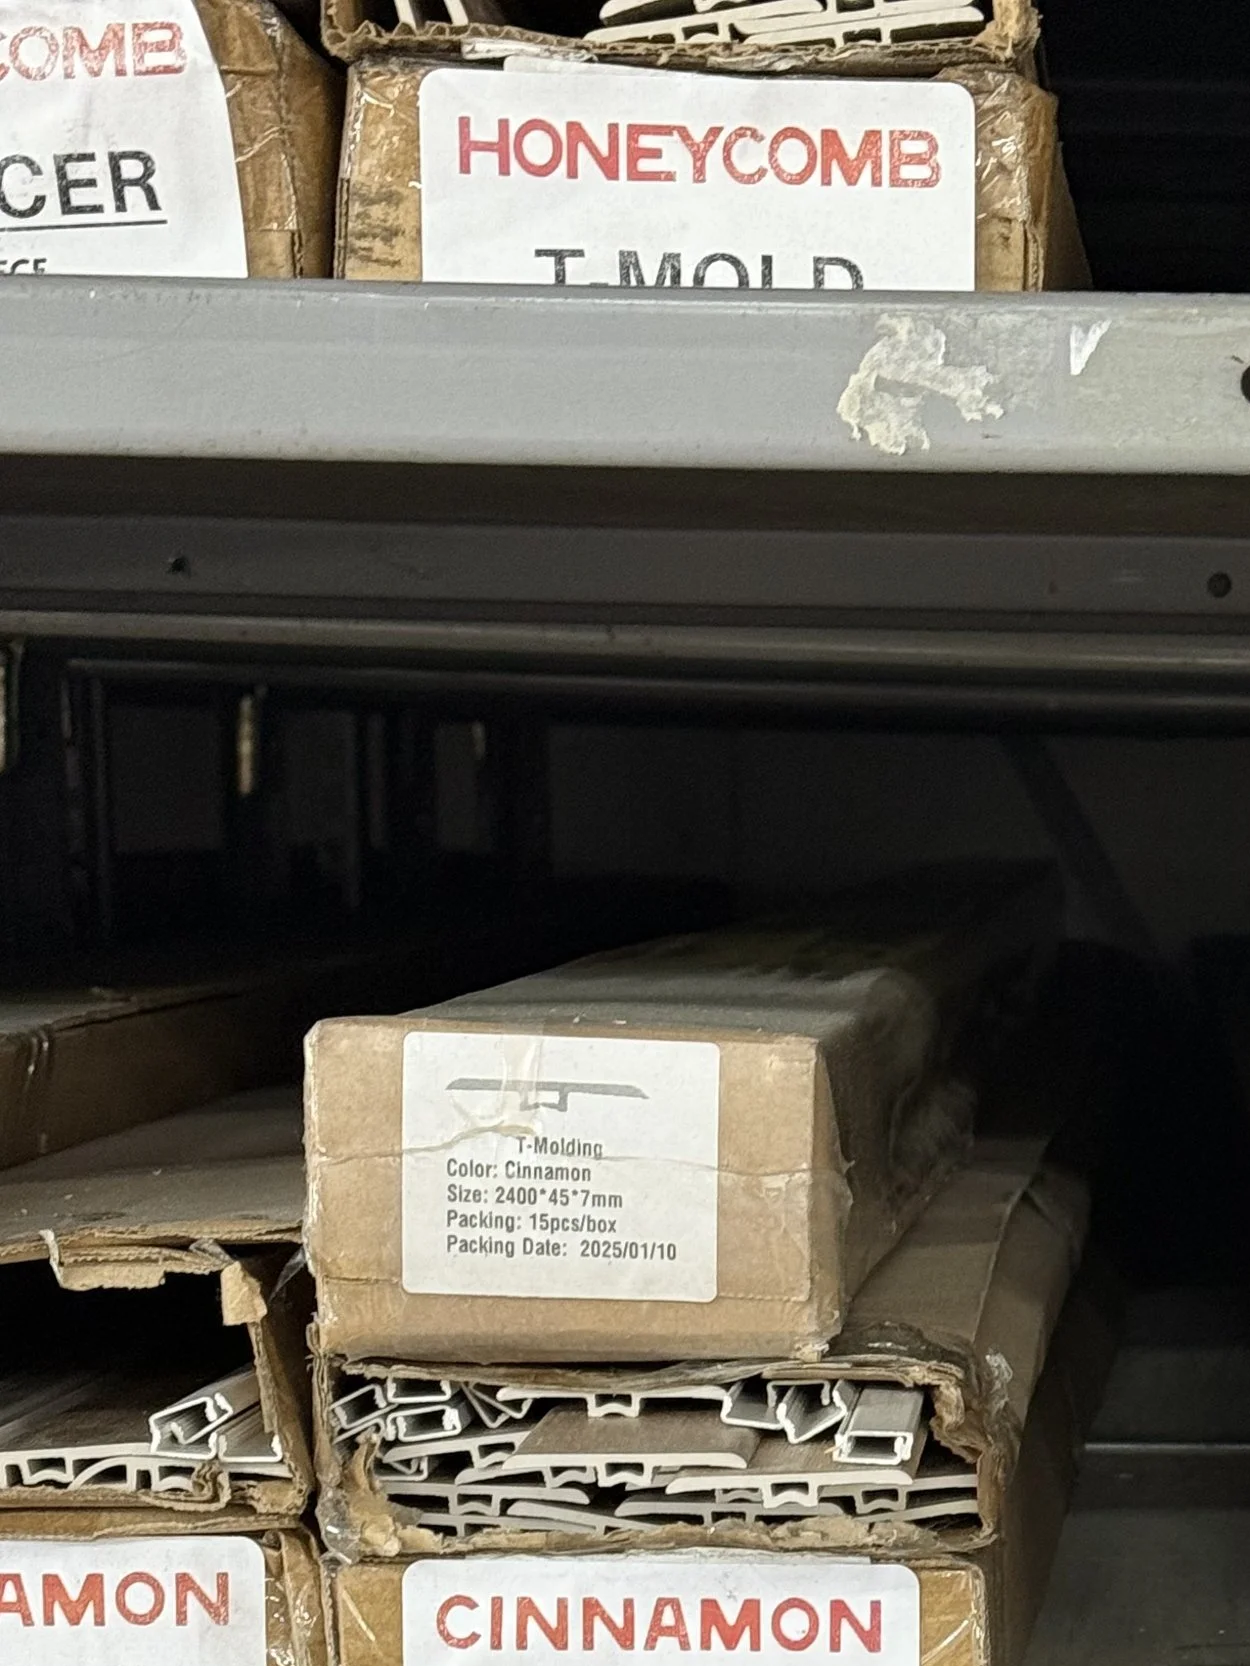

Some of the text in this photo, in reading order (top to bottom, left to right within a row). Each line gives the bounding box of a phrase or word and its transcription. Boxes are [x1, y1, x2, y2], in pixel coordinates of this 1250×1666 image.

[0, 21, 188, 82] OMB
[458, 116, 941, 188] HONEYCOMB
[517, 1136, 603, 1158] T-Molding
[446, 1158, 592, 1182] Color: Cinnamon
[446, 1183, 489, 1204] Size:
[446, 1209, 617, 1235] Packing: 15pcs/box
[446, 1234, 677, 1261] Packing Date: 2025/01/10
[436, 1594, 882, 1653] CINNAMON
